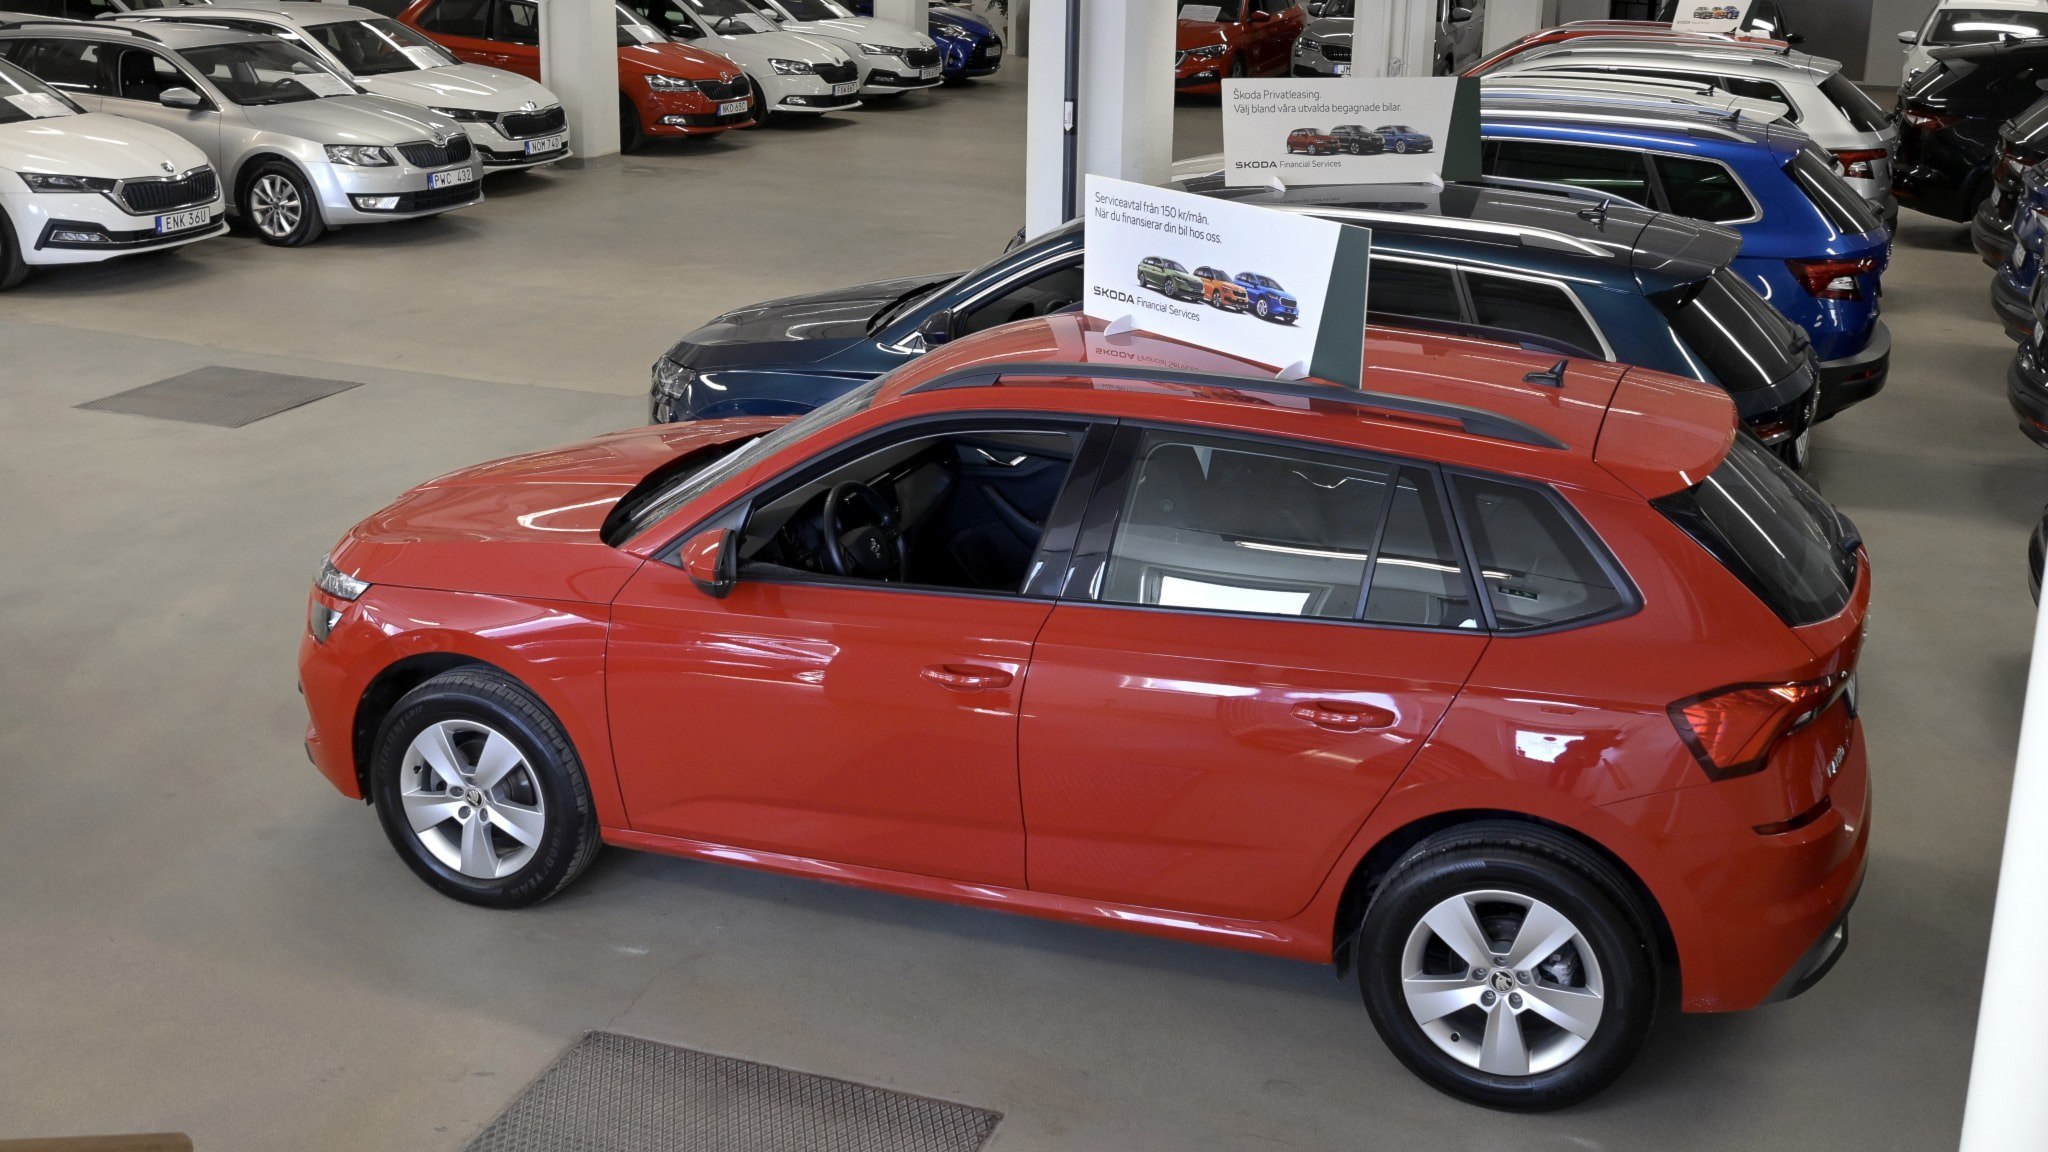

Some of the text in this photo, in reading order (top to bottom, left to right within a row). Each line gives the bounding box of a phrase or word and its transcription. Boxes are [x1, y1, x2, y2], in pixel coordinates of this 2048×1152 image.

[1233, 88, 1322, 101] Škoda Privatleasing.
[1234, 102, 1402, 115] Välj bland våra utvalda begagnade bilar.
[1279, 160, 1311, 168] Financial
[1311, 160, 1342, 168] Services
[434, 169, 472, 187] PWC 432
[1095, 191, 1210, 225] Serviceavtal från 150 kr/mån.
[166, 214, 186, 230] ENK
[1095, 207, 1222, 243] När du finansierar din bil hos oss.
[1136, 297, 1167, 313] Financial
[1168, 304, 1200, 322] Services
